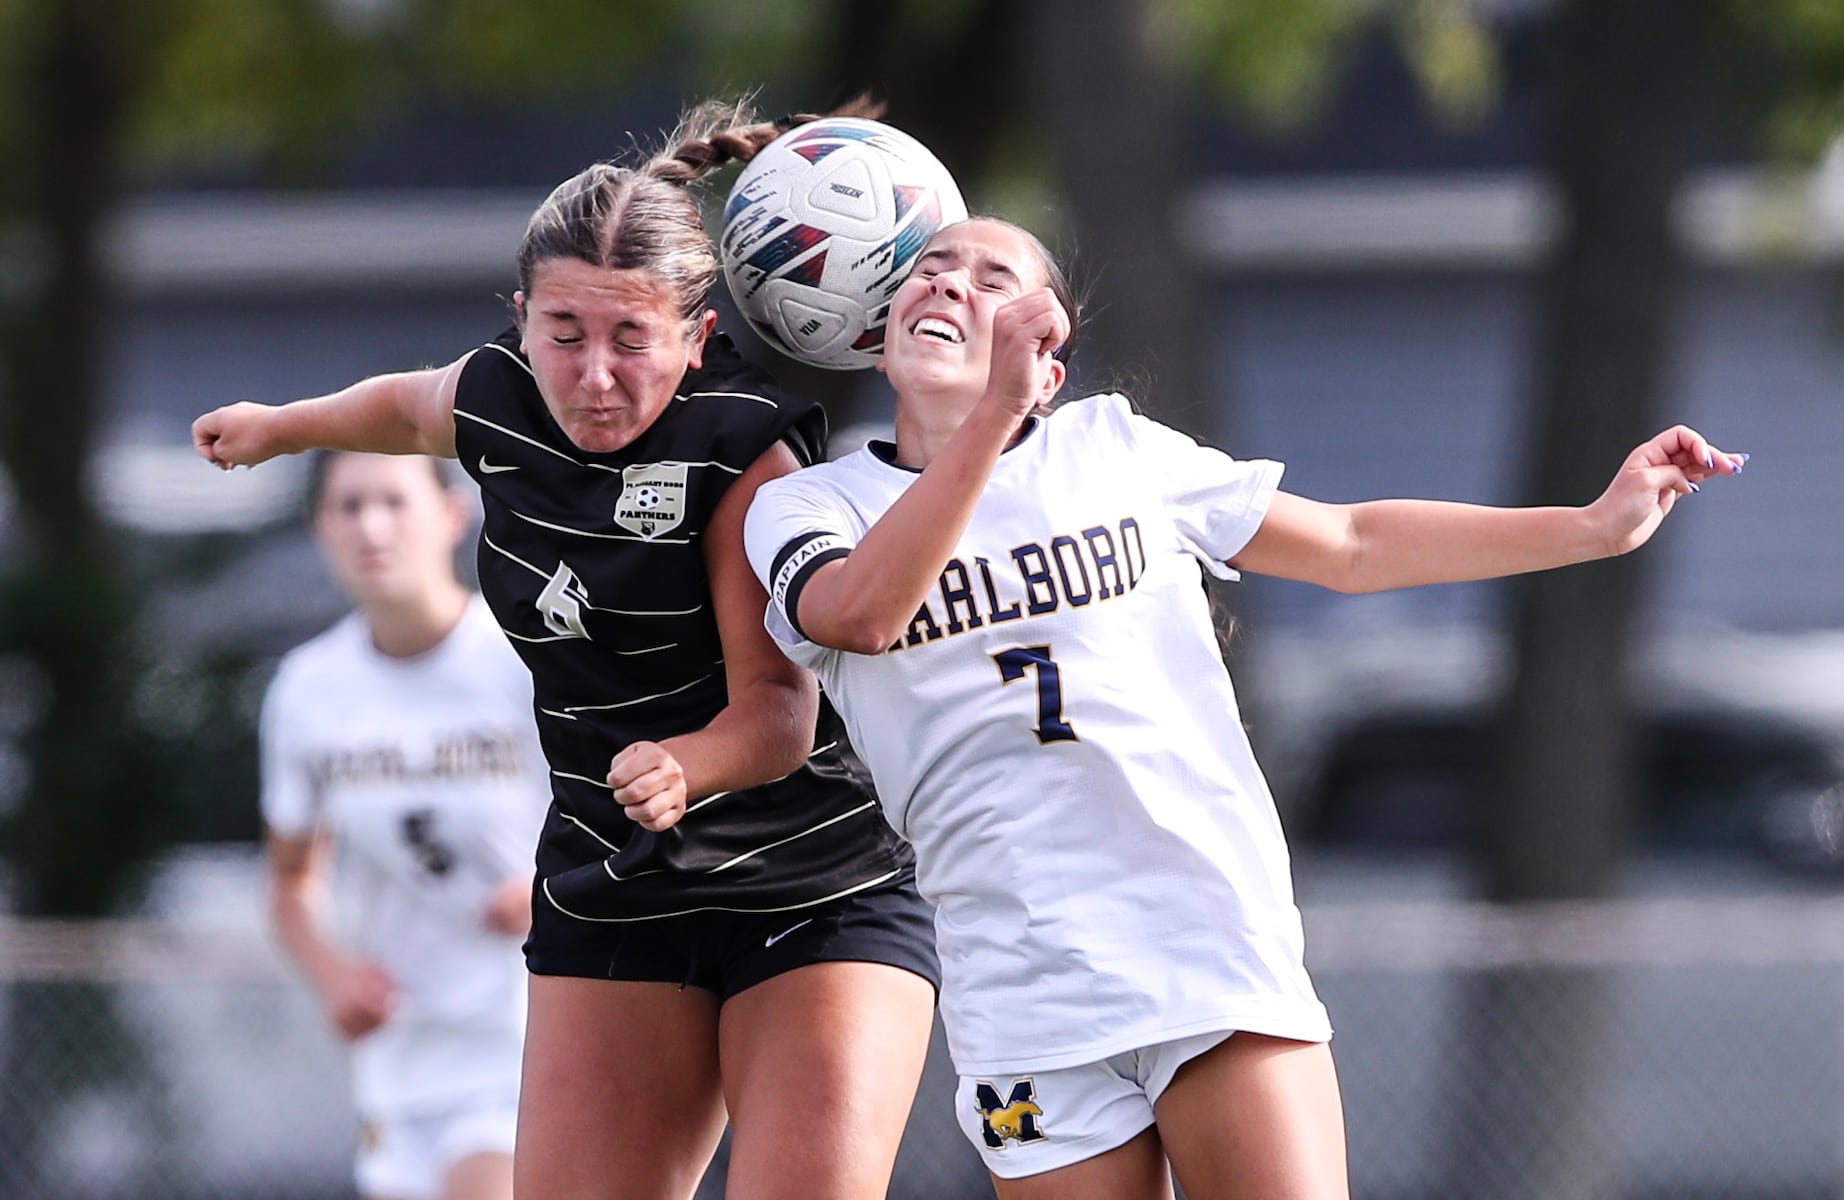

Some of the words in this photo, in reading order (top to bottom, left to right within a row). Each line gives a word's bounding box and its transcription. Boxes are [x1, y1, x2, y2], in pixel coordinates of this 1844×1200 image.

[620, 510, 676, 521] PANTHERS
[535, 559, 593, 641] 6
[776, 539, 831, 605] CAPTAIN
[888, 517, 1147, 655] ARLBORO
[991, 643, 1080, 746] 7
[975, 1076, 1049, 1151] M
